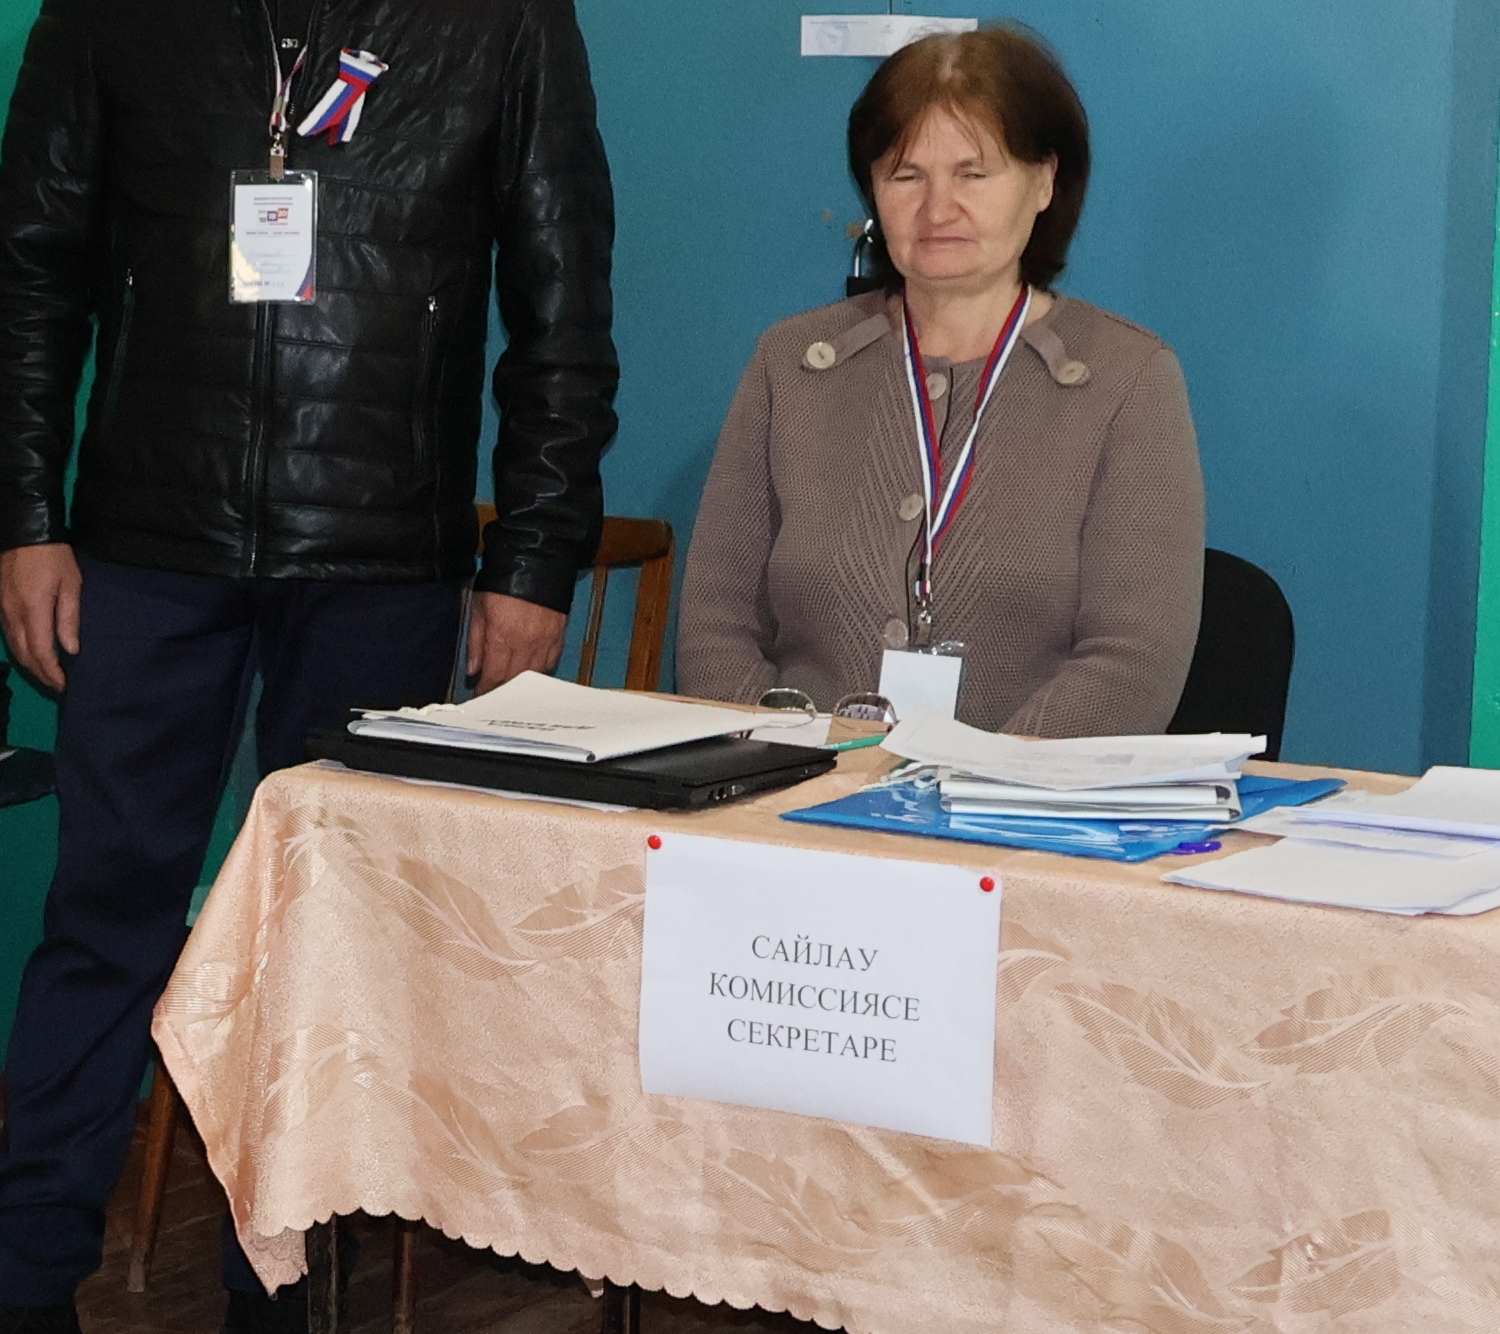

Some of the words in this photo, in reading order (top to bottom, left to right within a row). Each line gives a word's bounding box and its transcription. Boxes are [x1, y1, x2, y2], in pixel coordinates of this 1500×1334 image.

[751, 934, 879, 972] САЙЛАУ
[708, 972, 921, 1022] КОМИССИЯСЕ
[727, 1018, 898, 1063] СЕКРЕТАРЕ
